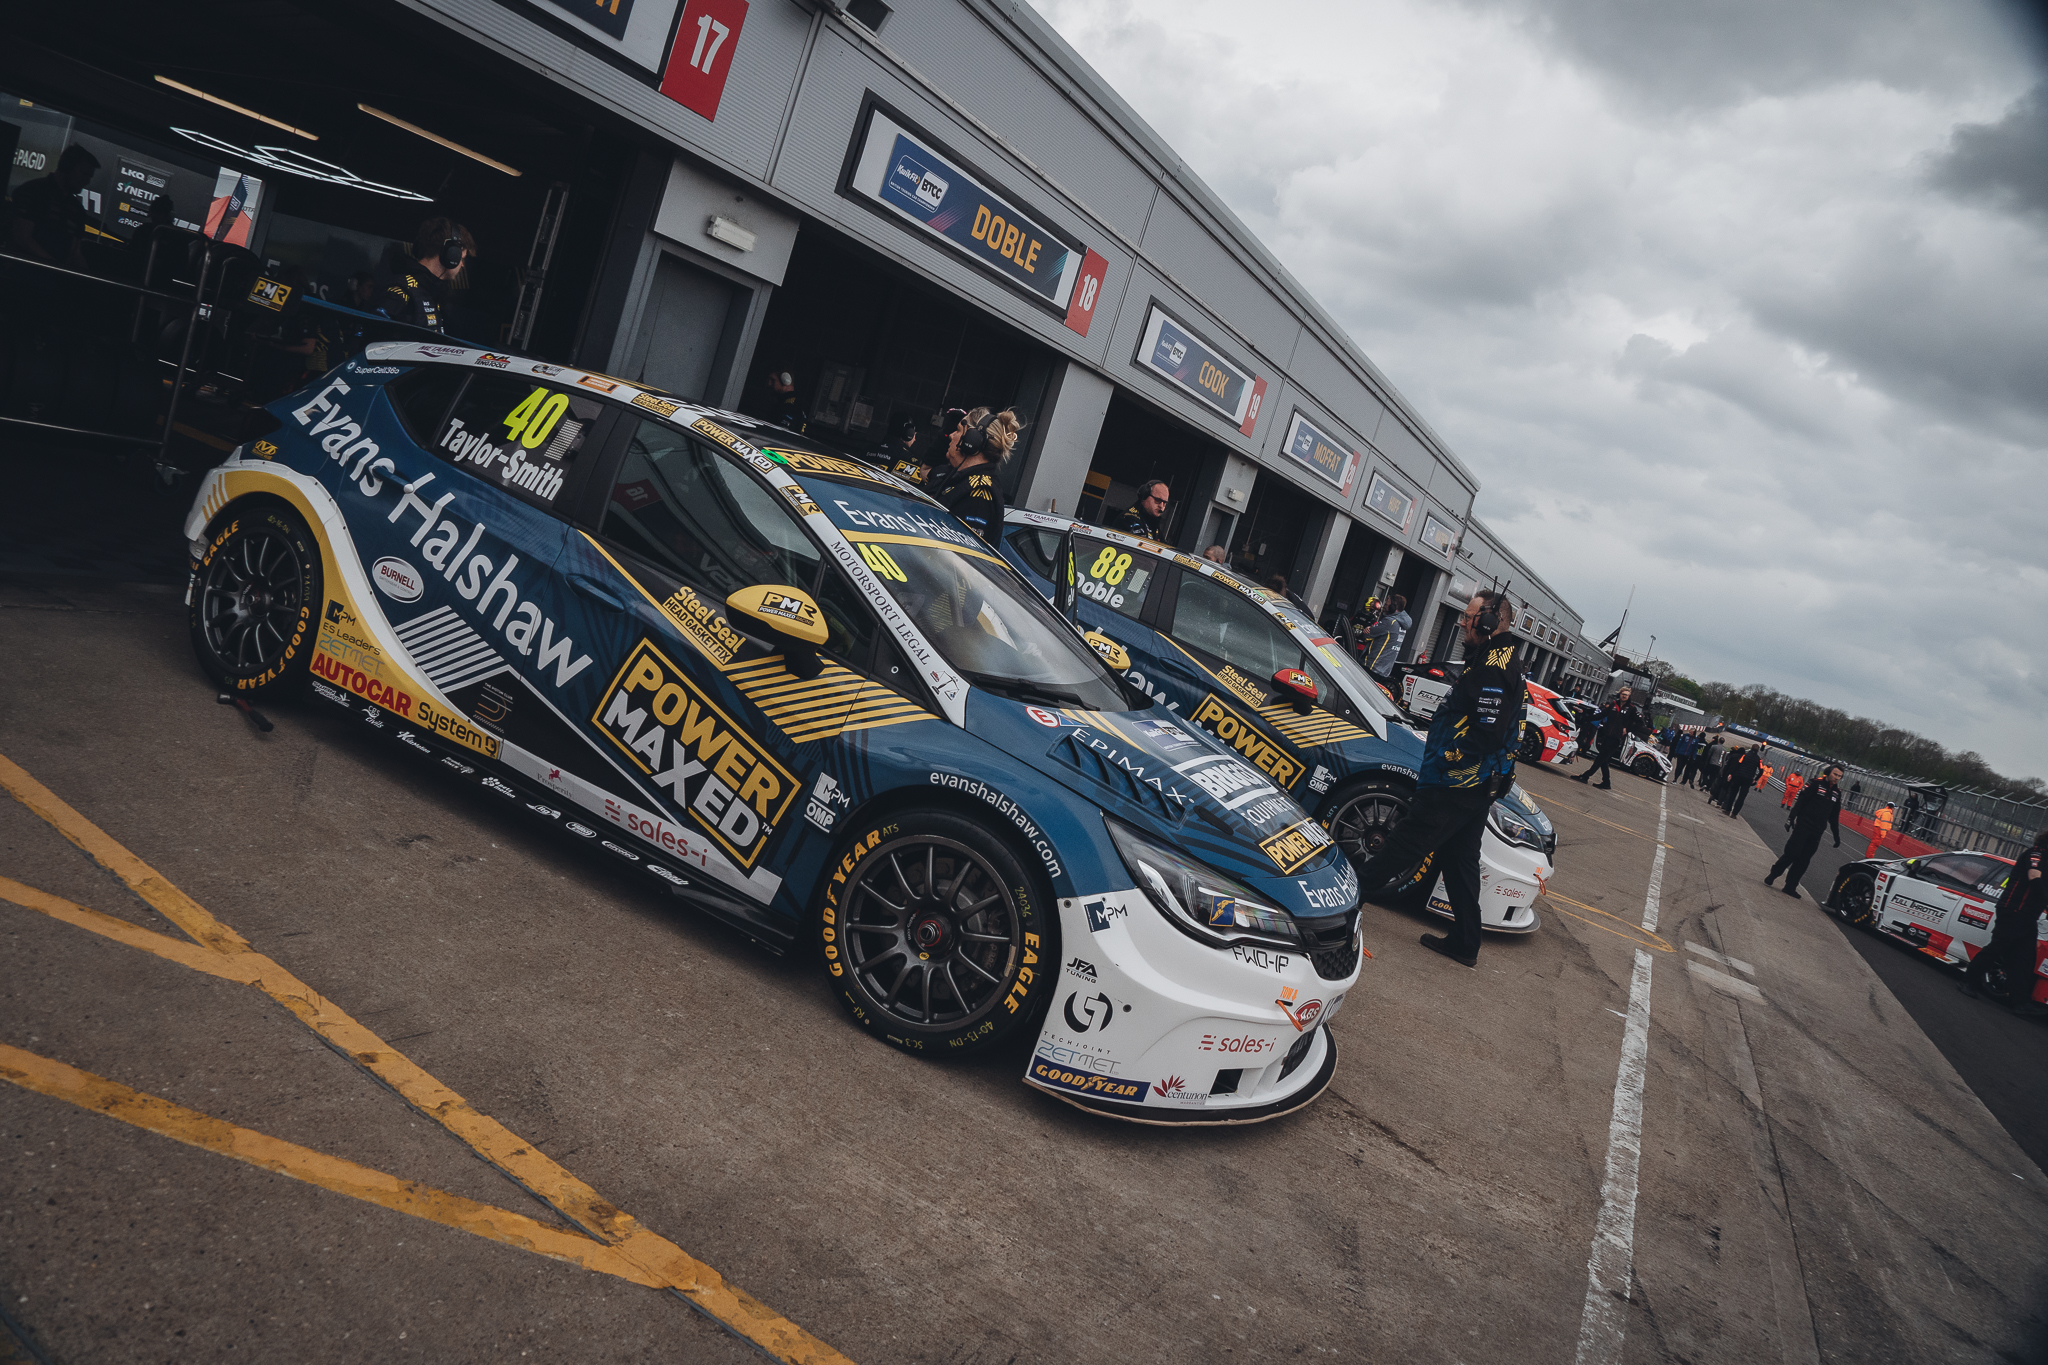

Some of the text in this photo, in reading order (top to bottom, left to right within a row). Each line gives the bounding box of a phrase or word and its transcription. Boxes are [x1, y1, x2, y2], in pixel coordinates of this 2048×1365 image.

[690, 14, 730, 75] 17
[17, 149, 46, 171] PAGID
[121, 167, 146, 182] LKQ
[897, 164, 920, 185] KwikFit
[921, 179, 943, 201] BTCC
[970, 203, 1042, 274] DOBLE
[253, 280, 287, 302] PMR
[1078, 273, 1098, 312] 18
[419, 344, 469, 356] METAMARK
[1198, 360, 1230, 399] COOK
[639, 393, 658, 406] Steel
[1247, 393, 1261, 420] 19
[502, 386, 569, 449] 40
[697, 420, 736, 445] POWER
[440, 417, 564, 501] Taylor-Smith
[731, 441, 773, 470] MAXED
[775, 450, 868, 479] POWER
[1313, 441, 1342, 473] MOFFAT
[786, 485, 821, 513] PMR
[291, 377, 594, 688] Evans Halshaw
[833, 500, 917, 534] Evans
[1023, 513, 1059, 523] METAMARK
[203, 520, 239, 566] EAGLE
[381, 565, 415, 591] BURNELL
[856, 542, 908, 583] 40
[1089, 546, 1133, 586] 88
[1213, 572, 1264, 603] POWER MAXED
[333, 608, 356, 627] MPM
[759, 606, 779, 615] POWER
[778, 611, 797, 620] MAXED
[763, 593, 818, 620] PMR
[830, 541, 931, 666] MOTORSPORT LEGAL
[664, 599, 732, 663] HEAD GASKET FIX
[674, 585, 747, 654] Steel Seal
[319, 632, 385, 675] ZETMET
[323, 622, 381, 656] ES Leaders
[1090, 639, 1121, 659] PMR
[311, 652, 412, 718] AUTOCAR
[1219, 671, 1261, 708] HEAD GASKET FIX
[1224, 665, 1268, 701] Steel Seal
[1418, 690, 1433, 700] FULL
[418, 701, 497, 755] System 9
[623, 653, 781, 819] POWER
[1198, 701, 1294, 787] POWER
[603, 689, 760, 847] MAXED
[1071, 727, 1187, 806] EPIMAX
[1189, 762, 1264, 799] BRIGGS
[825, 782, 850, 809] MPM
[1309, 779, 1328, 792] OMP
[806, 802, 835, 828] OMP
[882, 823, 900, 837] ATS
[930, 771, 1062, 879] evanshalshaw.com
[628, 813, 708, 868] sales-i
[1266, 830, 1314, 868] POWER
[1297, 880, 1346, 908] Evans
[1502, 888, 1527, 899] sales-i
[1891, 894, 1949, 919] FULL THROTTLE
[1095, 904, 1128, 924] MPM
[1003, 931, 1040, 1015] EAGLE
[1065, 968, 1097, 985] TUNING
[1067, 957, 1098, 979] JFA
[949, 1021, 995, 1048] 40-13-DN
[1217, 1034, 1277, 1053] sales-i
[1038, 1040, 1121, 1075] ZETMET
[1035, 1063, 1139, 1097] GOODYEAR
[1167, 1090, 1208, 1101] centurion
